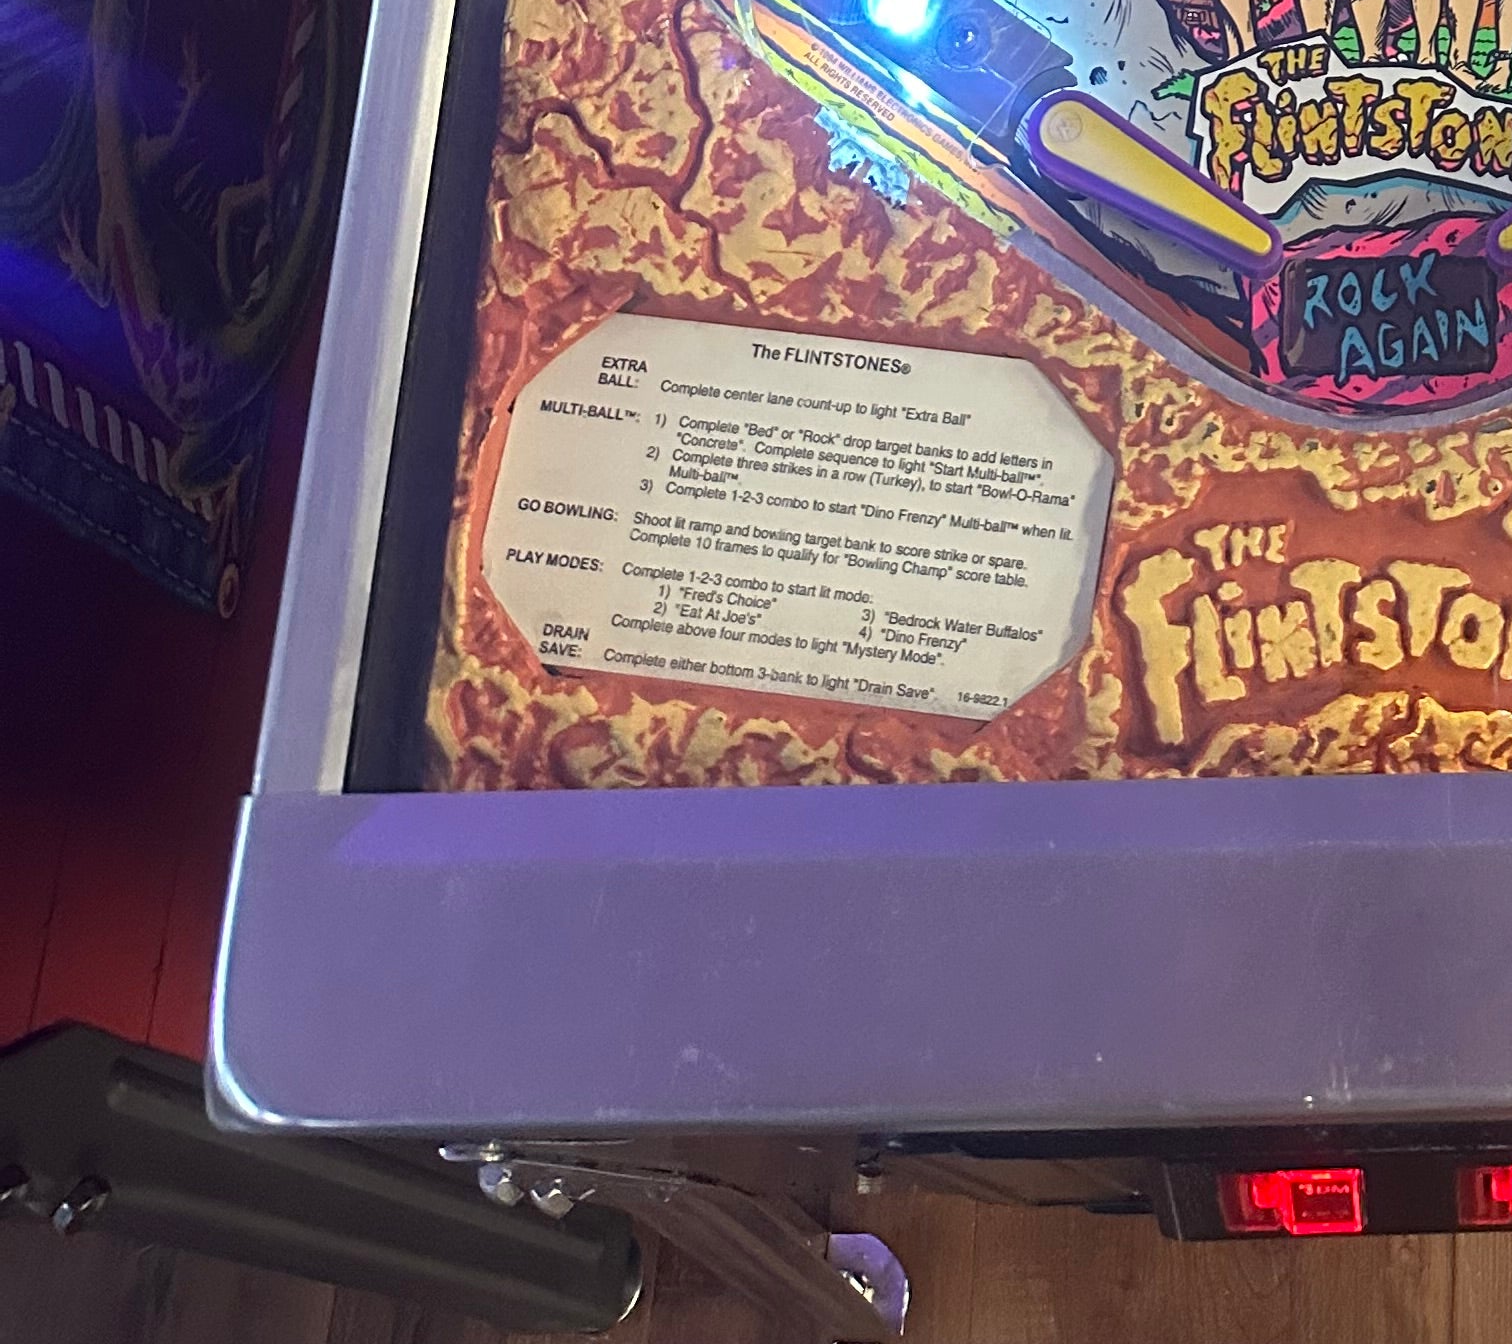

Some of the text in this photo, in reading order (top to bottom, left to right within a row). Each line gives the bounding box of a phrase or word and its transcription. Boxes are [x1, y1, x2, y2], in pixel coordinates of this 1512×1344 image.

[1259, 43, 1330, 84] THE
[820, 62, 851, 90] RIGHTS
[850, 85, 896, 122] RESERVED
[1303, 252, 1440, 327] ROCK
[752, 344, 781, 360] The
[1335, 298, 1493, 385] AGAIN
[597, 373, 640, 389] BALL:
[601, 356, 649, 374] EXTRA
[659, 379, 720, 398] Complete
[722, 389, 764, 403] center
[766, 391, 794, 406] lane
[796, 397, 852, 415] count-up
[854, 402, 867, 414] to
[869, 402, 897, 420] light
[516, 496, 619, 523] GO BOWLING:
[632, 511, 1024, 570] Shoot lit ramp and bowling target bank to score strike or spare.
[1194, 520, 1291, 571] THE
[505, 547, 604, 573] PLAY MODES:
[628, 528, 691, 550] Complete
[695, 535, 712, 550] 10
[714, 537, 758, 556] frames
[760, 543, 774, 557] to
[776, 547, 819, 565] qualify
[822, 550, 841, 564] for
[954, 569, 991, 584] score
[993, 571, 1028, 588] table.
[658, 583, 672, 601] 1)
[539, 621, 591, 642] DRAIN
[860, 608, 875, 625] 3)
[944, 617, 983, 635] Water
[536, 638, 584, 660] SAVE:
[602, 648, 666, 668] Complete
[669, 656, 707, 672] either
[708, 660, 754, 678] bottom
[756, 666, 803, 684] 3-bank
[805, 673, 818, 686] to
[820, 673, 850, 693] light
